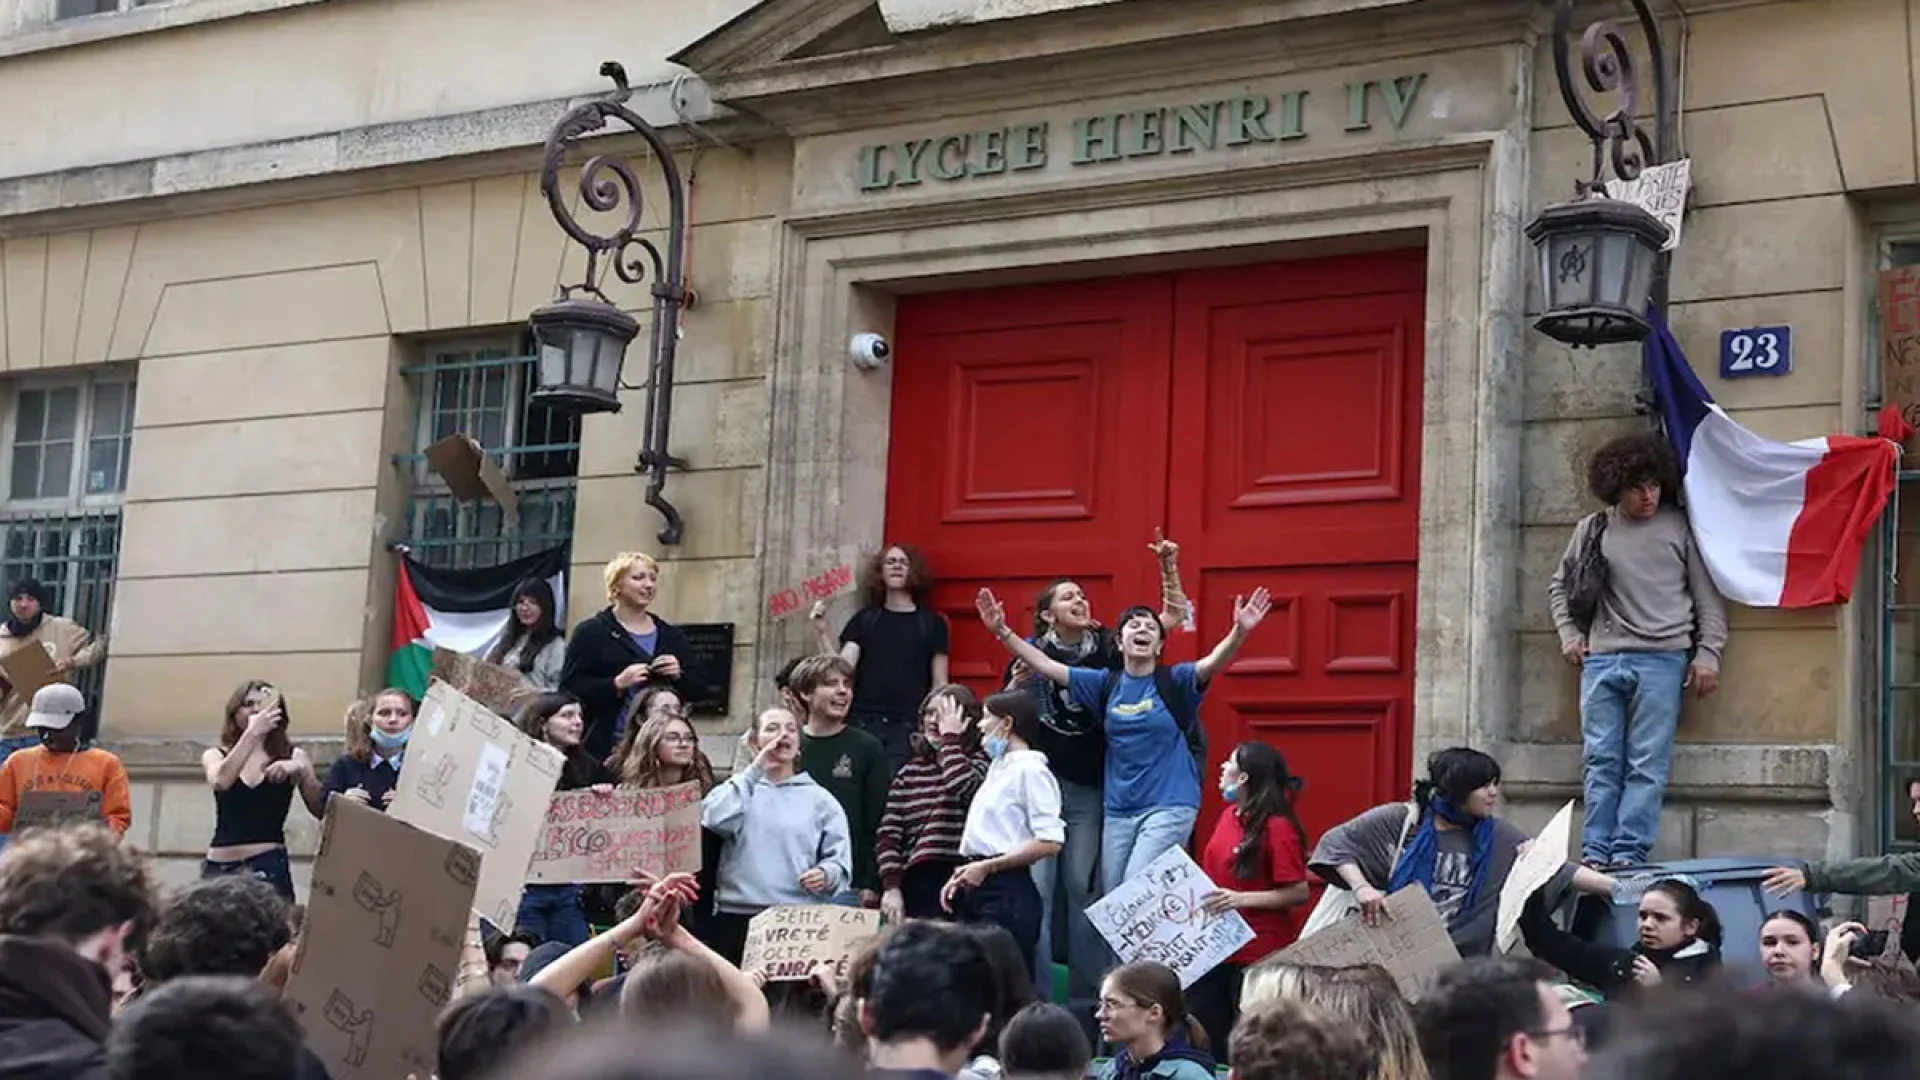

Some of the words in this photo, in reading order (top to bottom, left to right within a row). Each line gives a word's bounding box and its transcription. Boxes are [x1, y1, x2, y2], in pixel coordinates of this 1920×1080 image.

[859, 121, 1049, 192] LYCEE
[1070, 90, 1308, 165] HENRI
[1344, 74, 1427, 131] IV
[1729, 333, 1779, 371] 23
[840, 910, 865, 924] LA
[755, 923, 831, 943] VRETÉ
[765, 953, 849, 978] ENRAÉ
